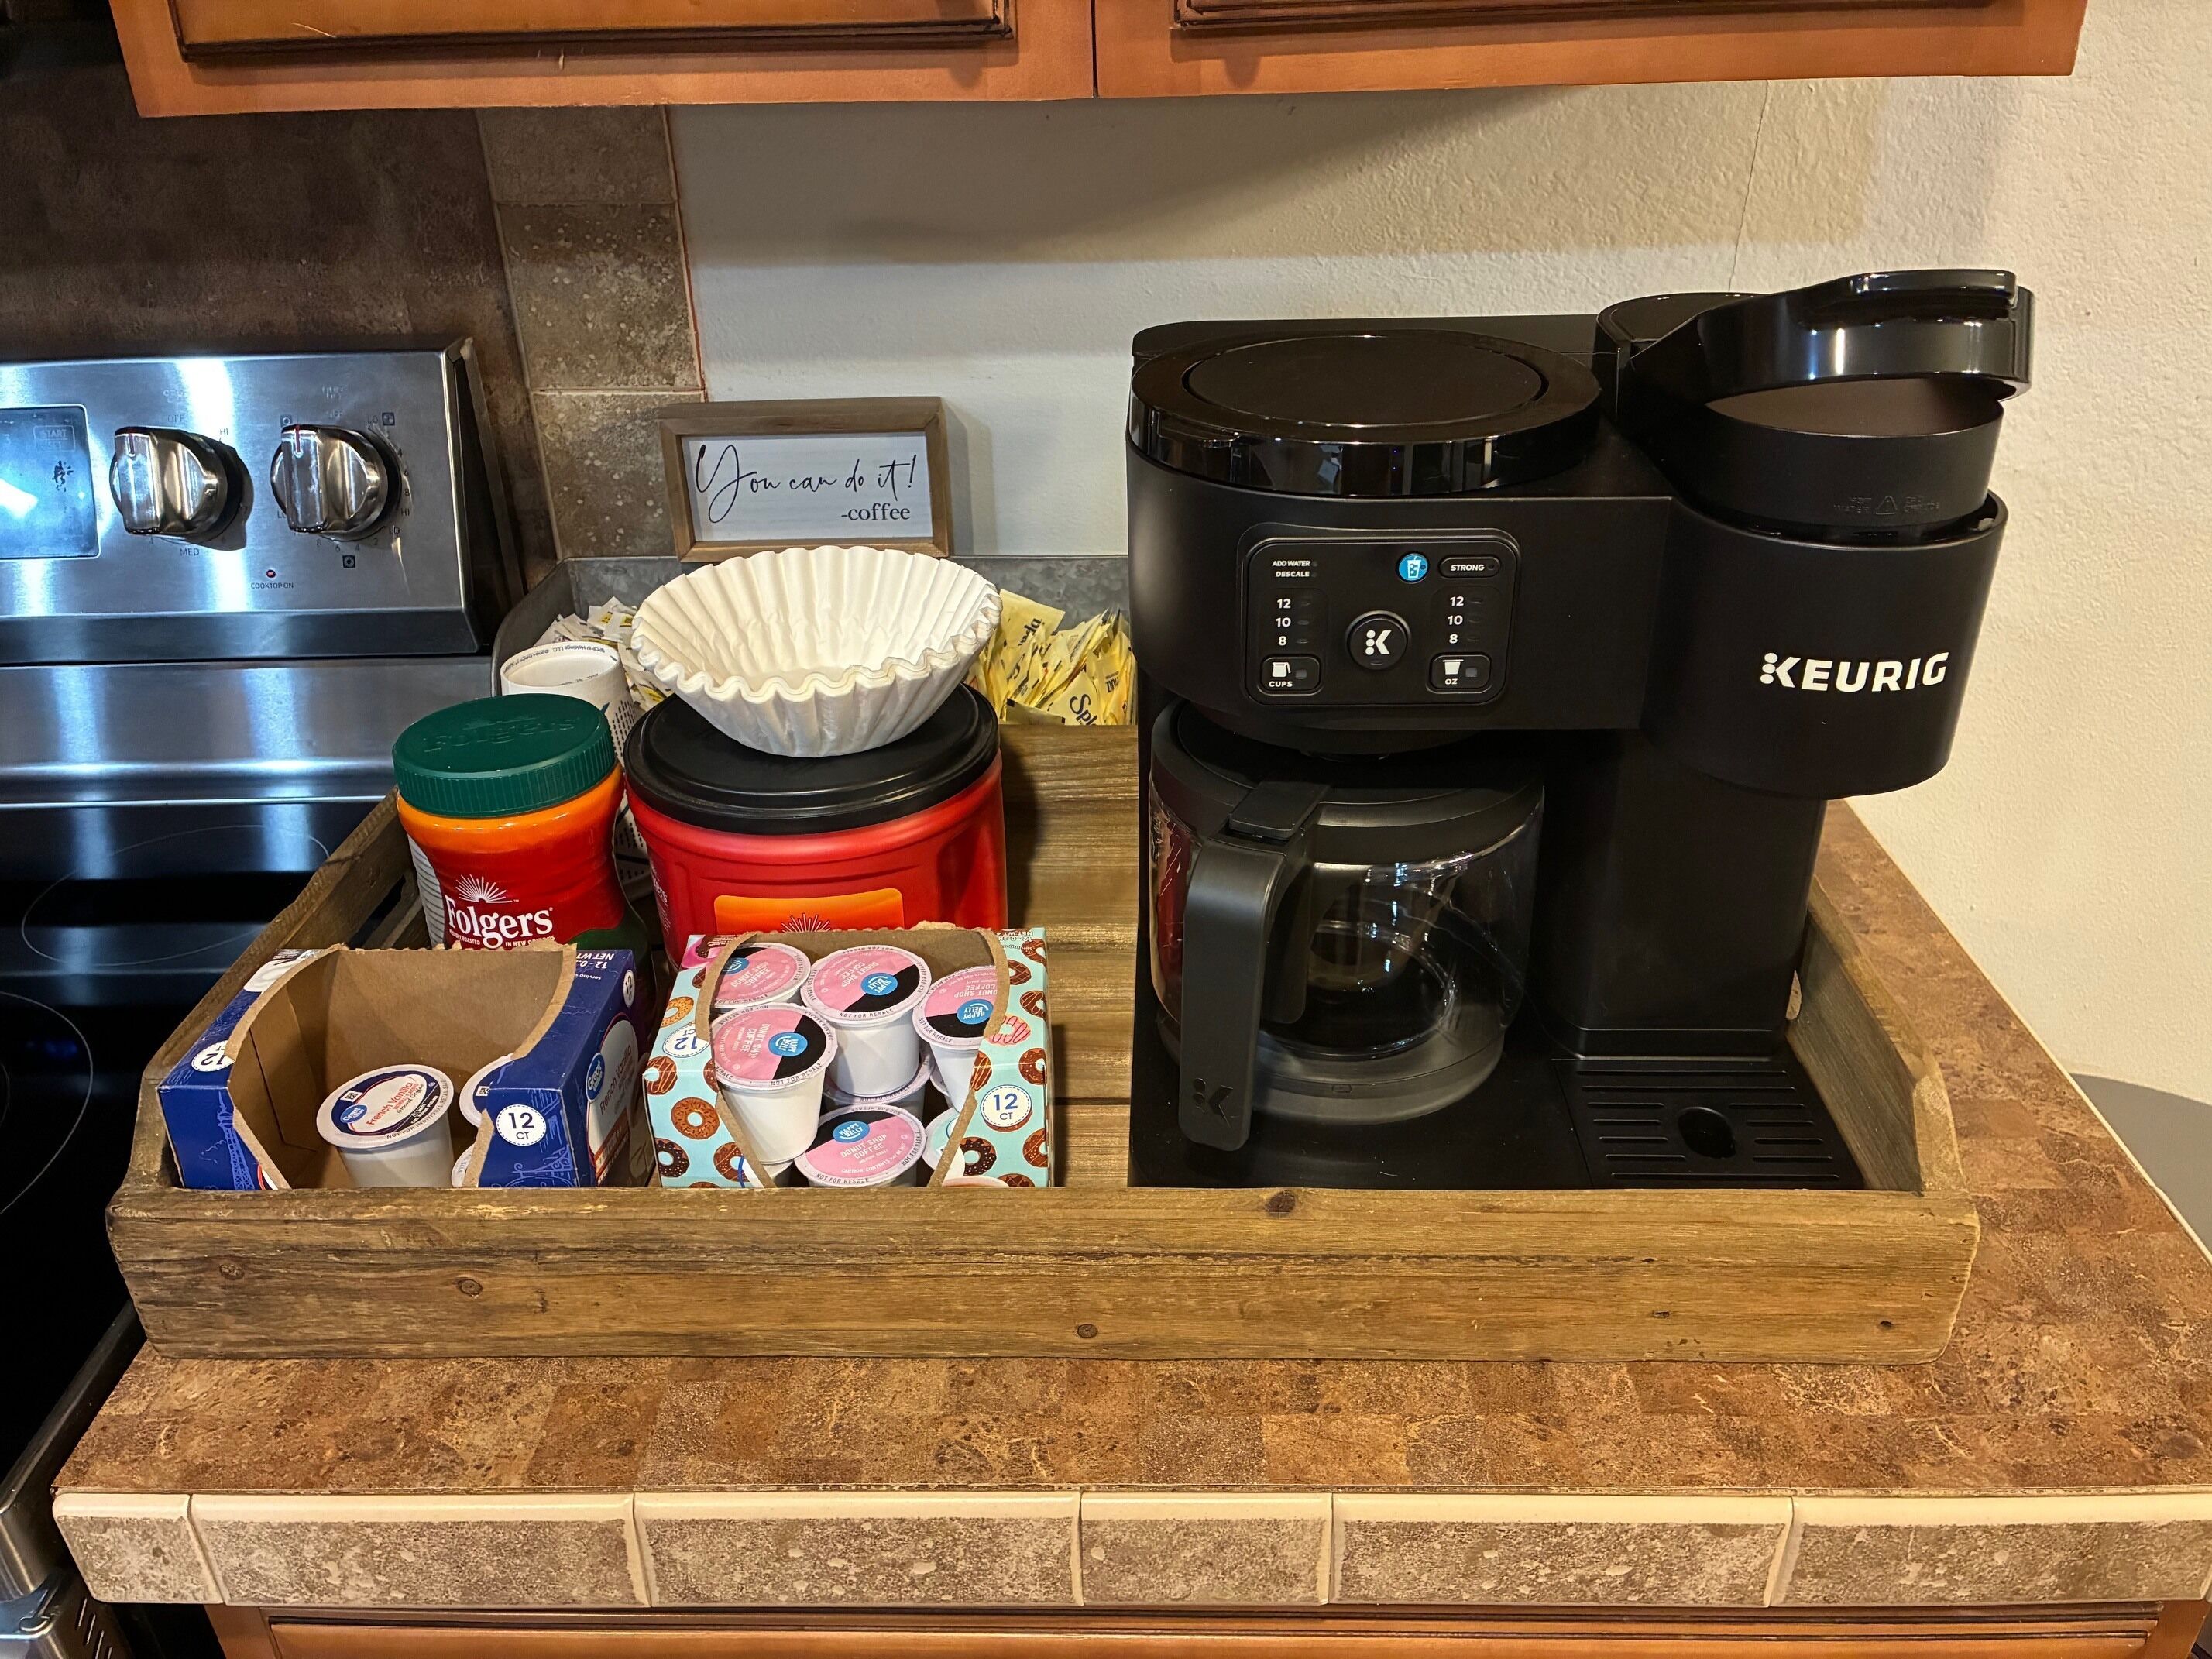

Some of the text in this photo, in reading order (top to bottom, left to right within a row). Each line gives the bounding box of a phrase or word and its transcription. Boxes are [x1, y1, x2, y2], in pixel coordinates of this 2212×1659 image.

[695, 445, 917, 524] You can do it!
[401, 508, 410, 517] HI
[840, 503, 911, 521] -coffee
[180, 548, 200, 556] MED
[1276, 598, 1292, 609] 12
[1449, 596, 1465, 606] 12
[1275, 617, 1292, 627] 10
[1447, 615, 1463, 626] 10
[1278, 636, 1287, 646] 8
[1448, 634, 1458, 644] 8
[1760, 651, 1949, 693] KEURIG
[445, 894, 553, 949] Folgers
[462, 936, 481, 946] ROASTED
[744, 967, 771, 987] COFFEE
[840, 961, 866, 980] COFFEE
[841, 961, 880, 988] DONUT SHOP
[730, 970, 753, 988] DONUT
[867, 977, 885, 990] BELLY
[874, 979, 893, 994] HAPPY
[869, 1008, 895, 1018] RESALE
[963, 1012, 985, 1020] HAPPY
[674, 1036, 698, 1050] 12
[740, 1027, 754, 1053] COFFEE
[748, 1023, 772, 1059] DONUT SHOP
[778, 1037, 791, 1052] BELLY
[932, 1032, 953, 1043] RESALE
[790, 1038, 799, 1053] HAPPY
[200, 1053, 225, 1066] 12
[587, 1060, 602, 1090] Great
[787, 1075, 800, 1084] FOR
[802, 1063, 823, 1079] RESALE
[397, 1084, 424, 1115] Ground Coffee
[599, 1077, 617, 1115] French
[994, 1093, 1018, 1111] 12
[366, 1104, 393, 1126] French
[390, 1082, 414, 1104] Vanilla
[343, 1107, 361, 1121] Great
[402, 1126, 415, 1135] FOR
[416, 1104, 444, 1128] INDIVIDUAL
[508, 1112, 535, 1130] 12
[999, 1112, 1014, 1121] CT
[839, 1122, 860, 1135] HAPPY
[843, 1126, 864, 1138] BELLY
[515, 1132, 529, 1140] CT
[840, 1134, 888, 1159] DONUT SHOP
[853, 1143, 885, 1159] COFFEE
[865, 1159, 891, 1173] CONTENTS
[901, 1156, 912, 1166] NOT
[816, 1173, 828, 1181] NOT
